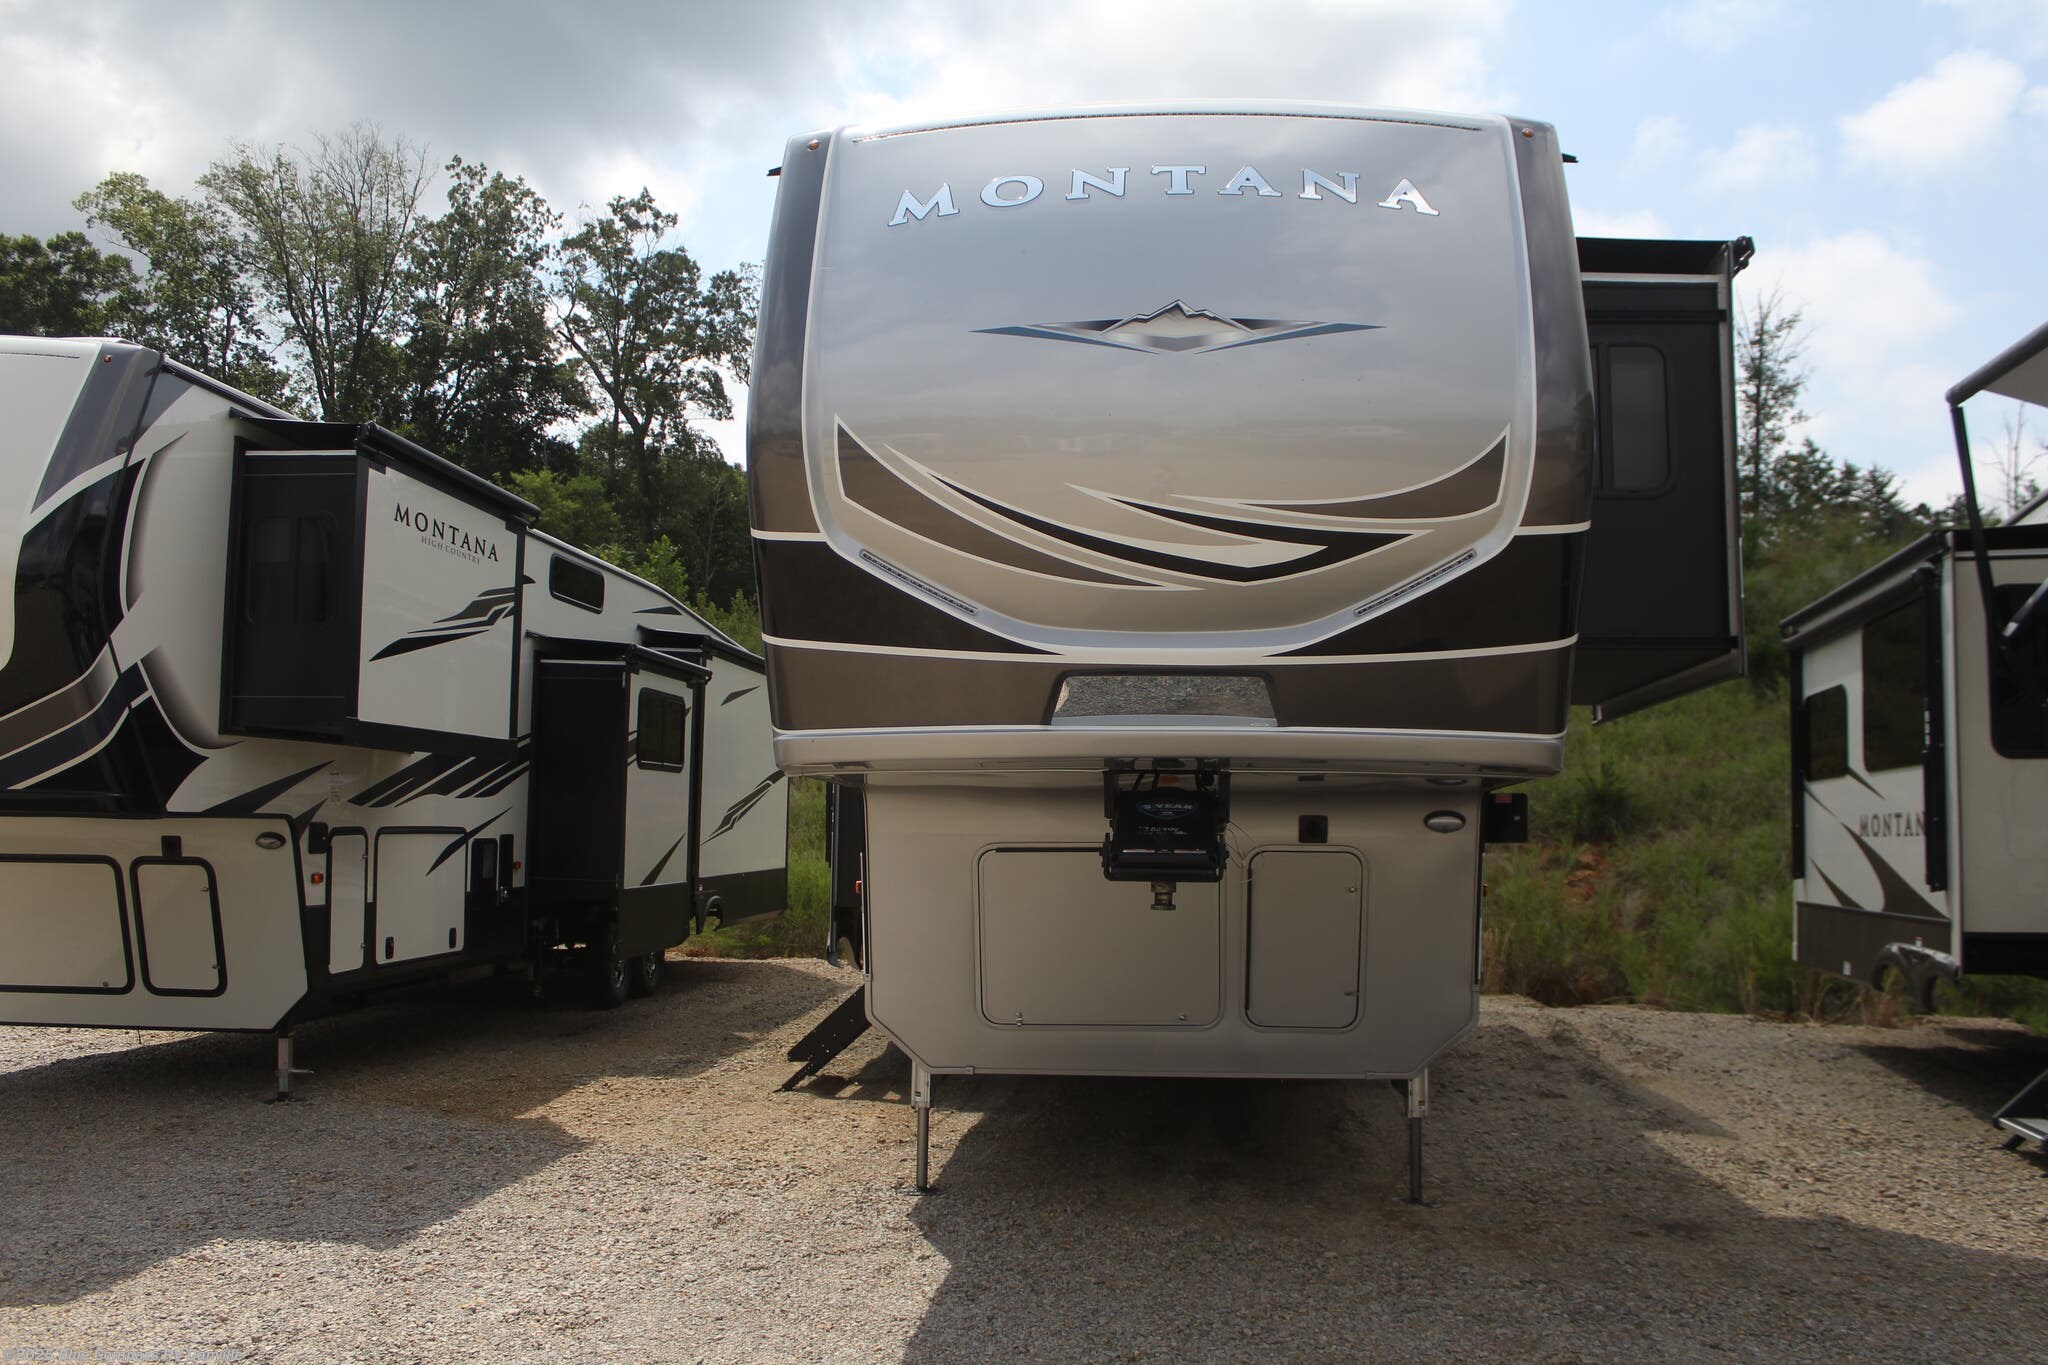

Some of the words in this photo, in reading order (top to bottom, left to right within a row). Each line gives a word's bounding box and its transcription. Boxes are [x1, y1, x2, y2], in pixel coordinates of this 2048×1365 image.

[888, 164, 1440, 228] MONTANA
[393, 501, 499, 562] MONTANA
[421, 535, 444, 551] HIGH
[445, 545, 480, 565] COUNTRY
[1859, 811, 1926, 837] MONTAN
